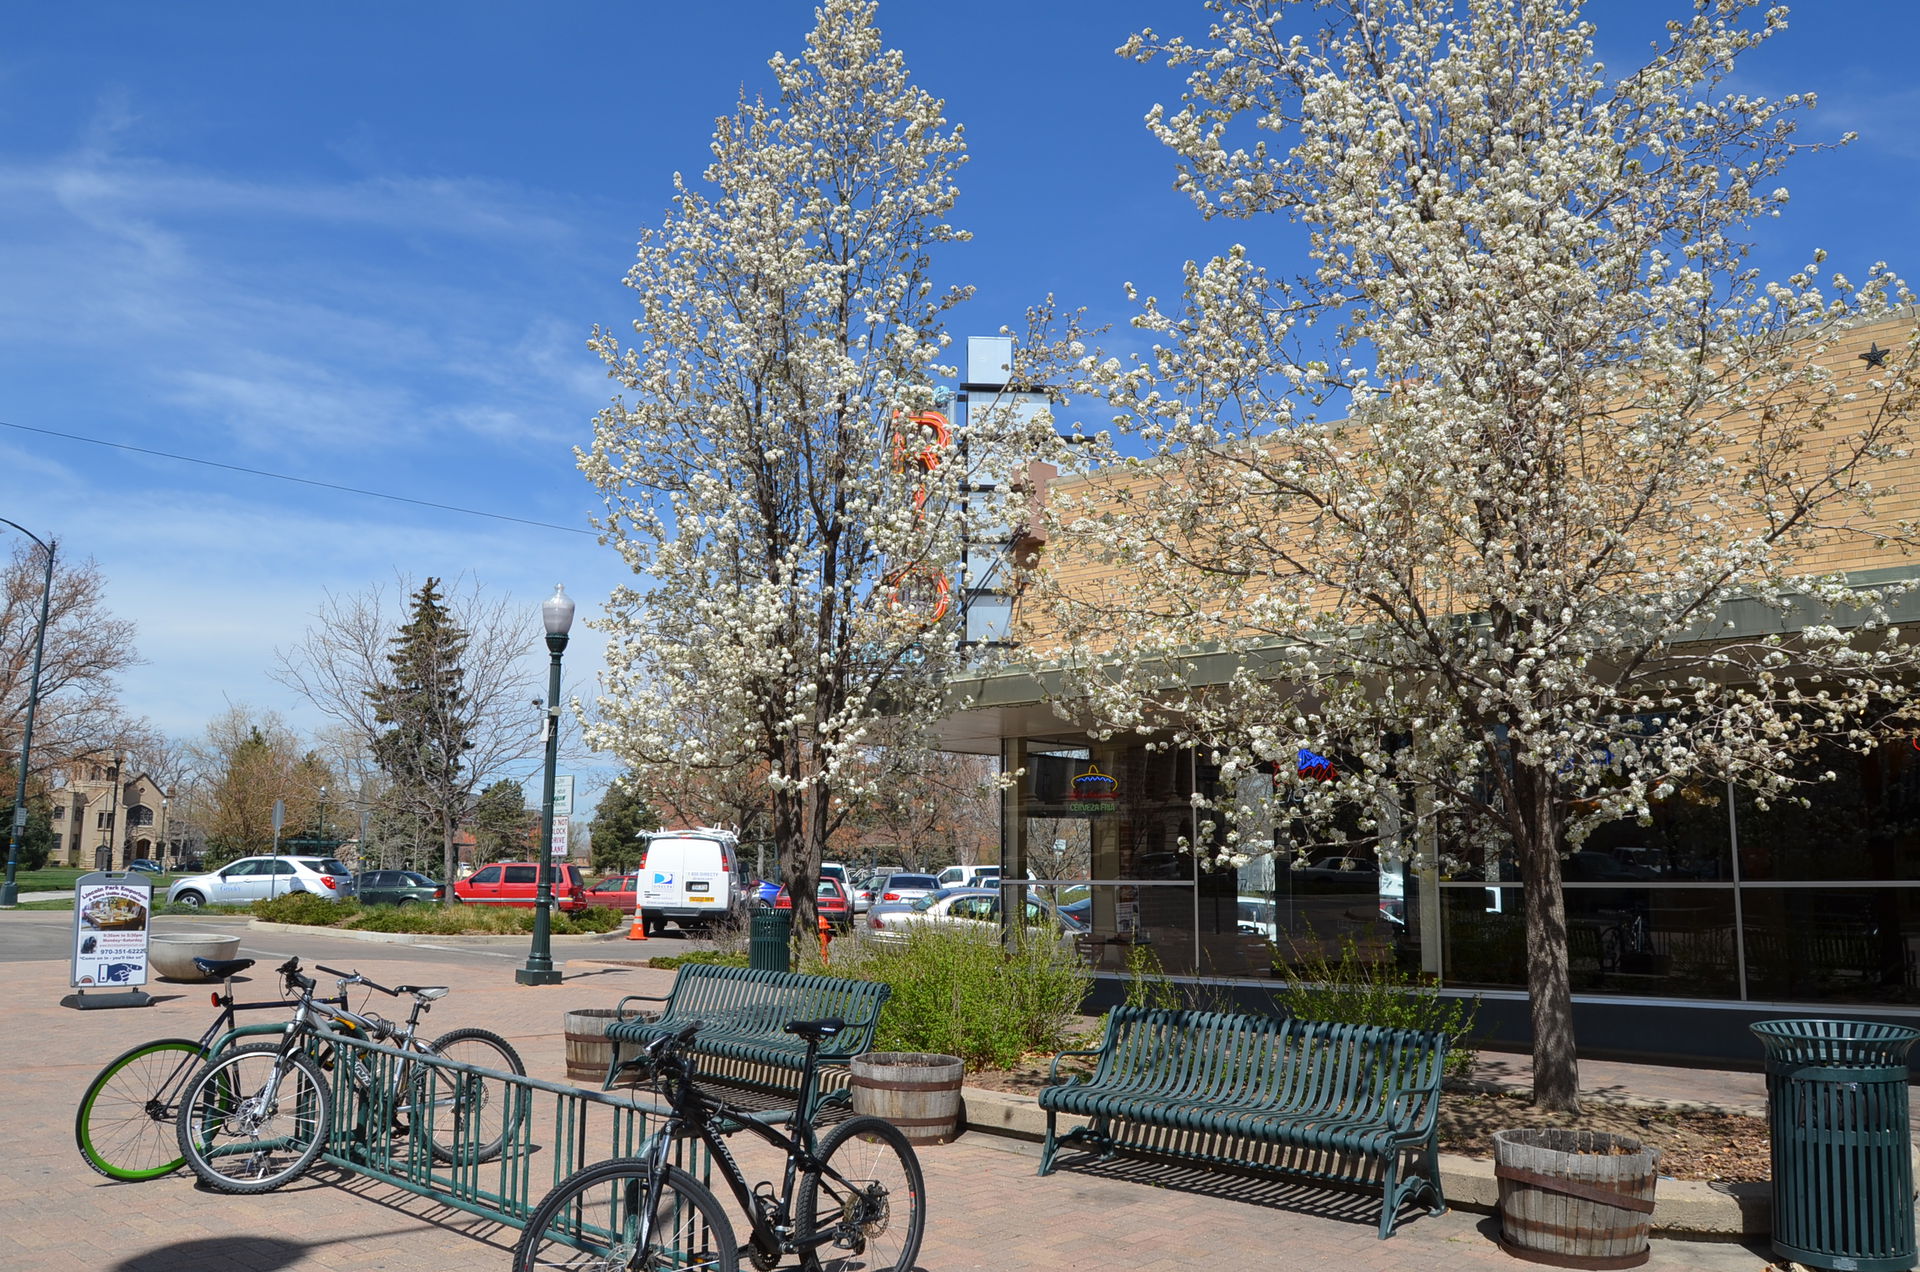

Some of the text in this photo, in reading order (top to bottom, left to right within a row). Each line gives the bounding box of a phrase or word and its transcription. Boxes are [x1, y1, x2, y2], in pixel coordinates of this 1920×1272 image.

[82, 887, 104, 900] Lincoln
[120, 885, 148, 900] Emporium
[703, 1120, 745, 1185] SPECIALIZED
